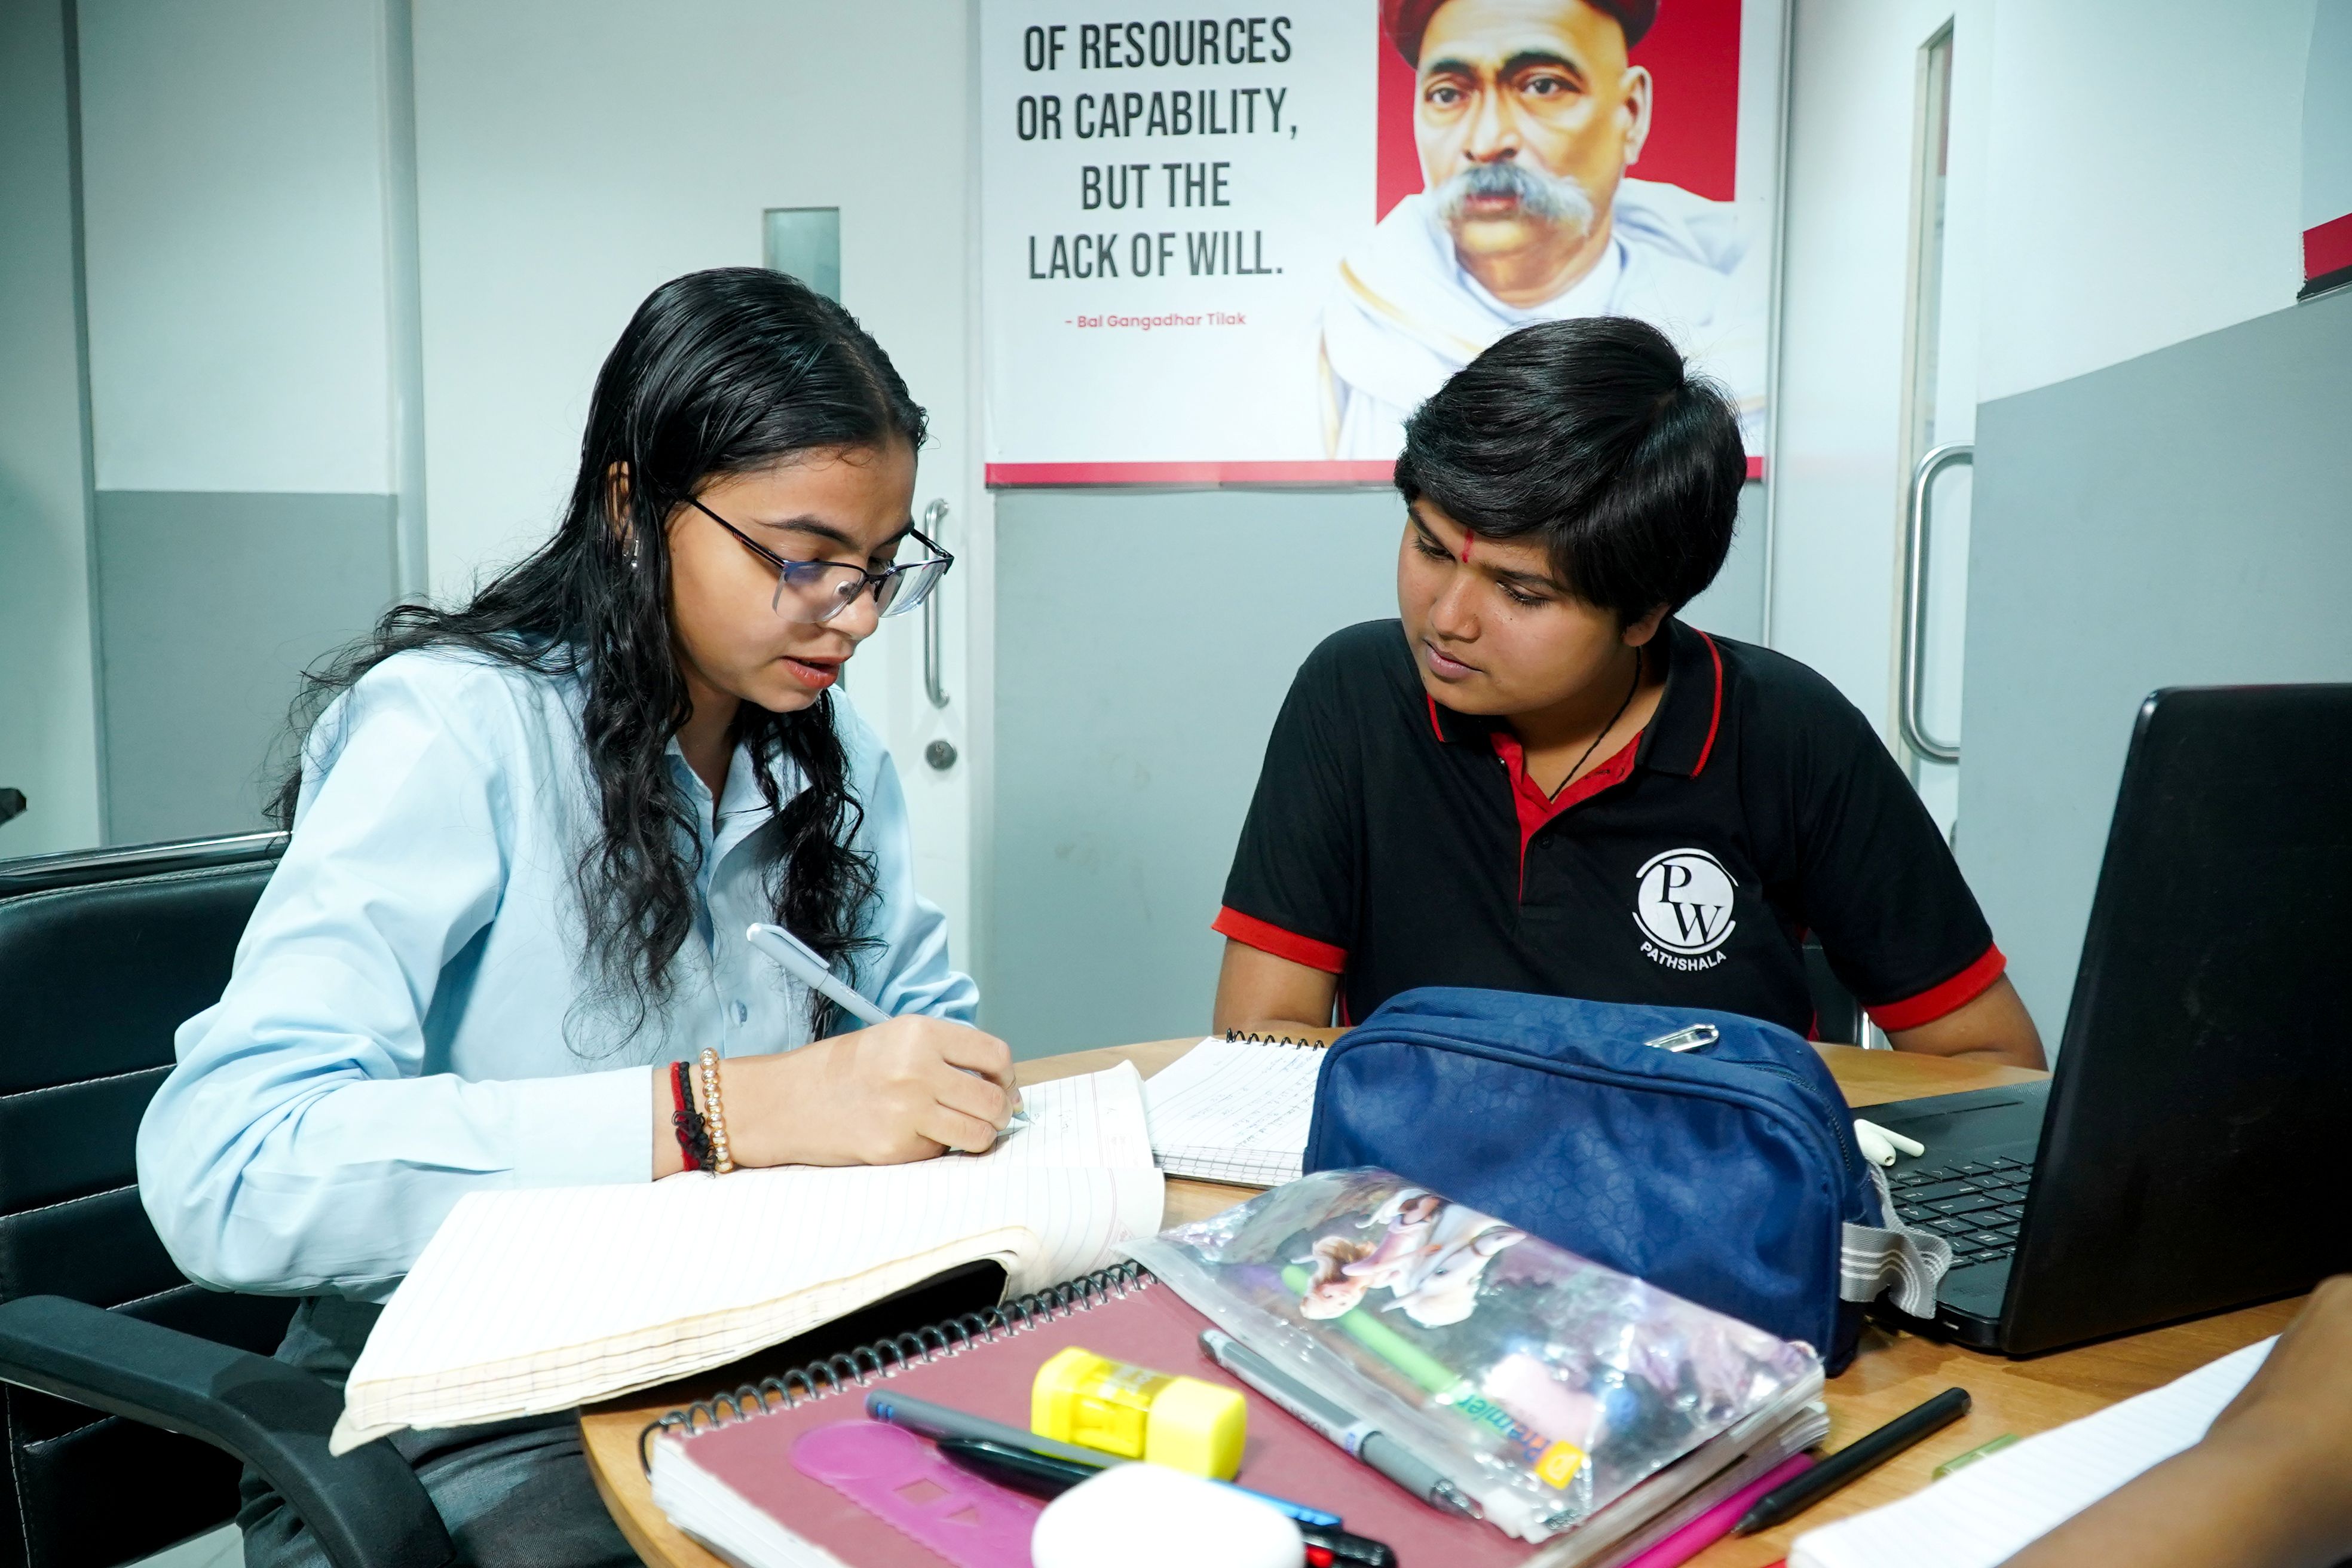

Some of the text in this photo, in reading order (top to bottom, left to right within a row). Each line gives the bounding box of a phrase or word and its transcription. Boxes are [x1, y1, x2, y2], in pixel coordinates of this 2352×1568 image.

[1024, 16, 1292, 72] OF RESOURCES
[1016, 87, 1298, 141] OR CAPABILITY,
[1082, 162, 1230, 210] BUT THE
[1029, 231, 1284, 279] LACK OF WILL.
[1077, 315, 1103, 328] Bal
[1107, 314, 1202, 330] Gangadhar
[1206, 311, 1247, 326] Tilak
[1640, 941, 1728, 972] PATHSHALA
